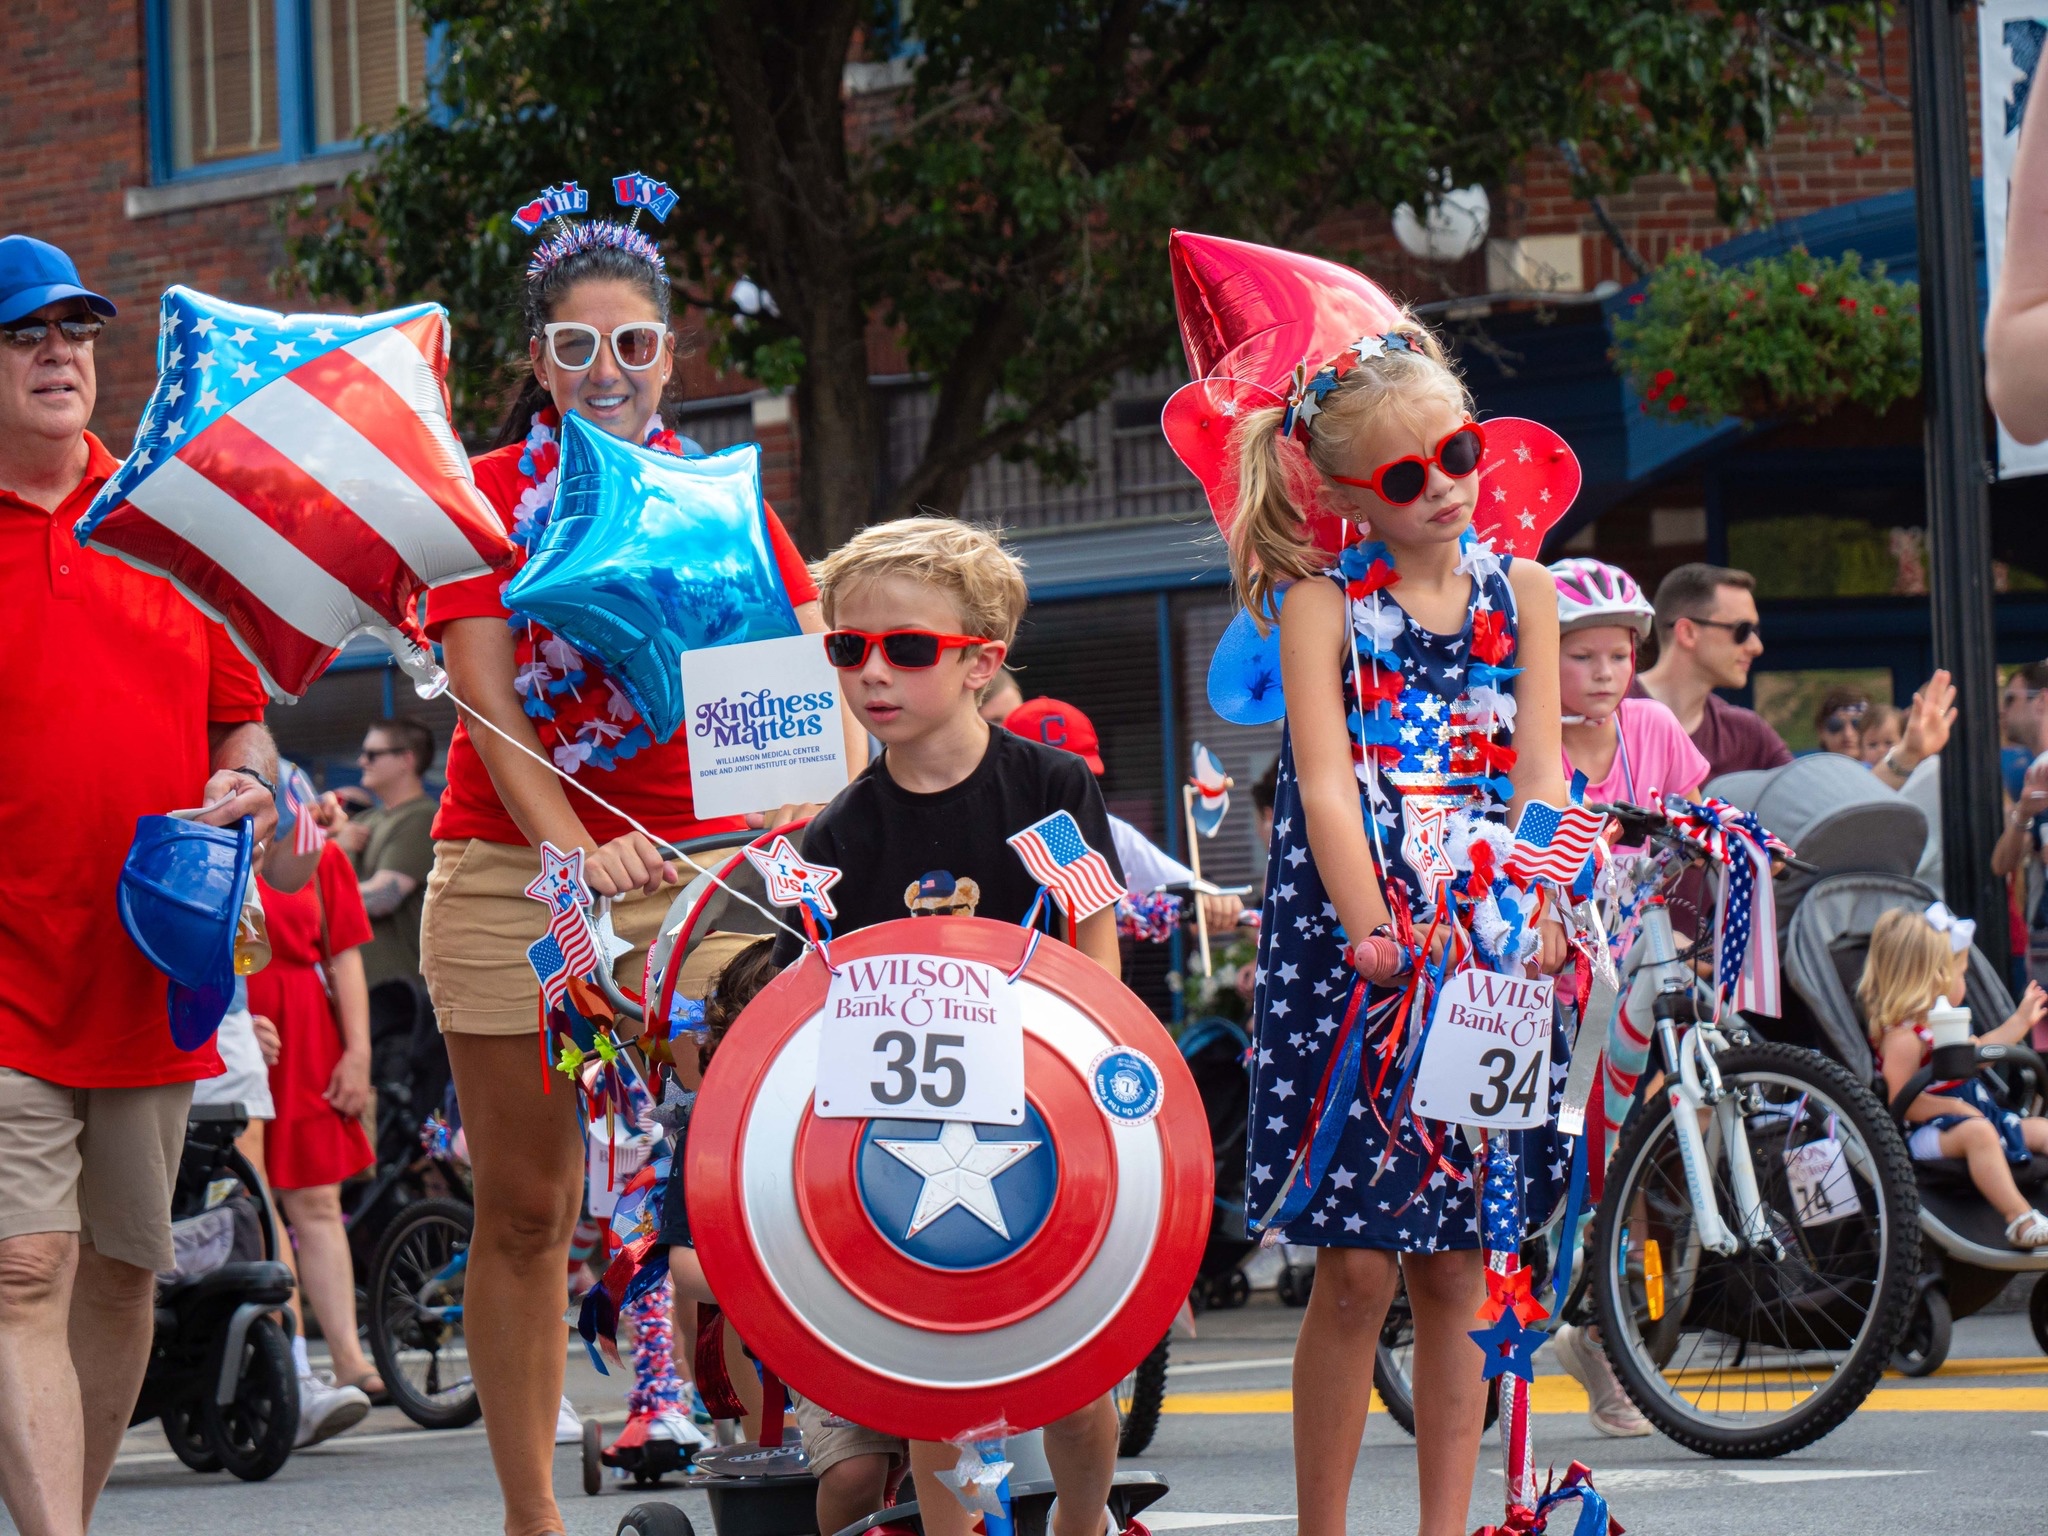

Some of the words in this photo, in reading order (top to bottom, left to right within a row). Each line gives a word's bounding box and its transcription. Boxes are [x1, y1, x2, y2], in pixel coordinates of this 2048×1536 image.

[513, 216, 533, 231] I
[542, 190, 585, 215] THE
[617, 177, 677, 219] USA
[694, 688, 834, 738] Kindness
[713, 713, 823, 751] Matters
[1040, 714, 1067, 746] C
[700, 768, 718, 778] BONE
[719, 766, 733, 775] AND
[734, 763, 753, 773] JOINT
[754, 759, 787, 770] INSTITUTE
[788, 757, 798, 766] OF
[798, 753, 836, 764] TENNESSEE
[715, 753, 760, 766] WILLIAMSON
[761, 749, 791, 760] MEDICAL
[792, 745, 820, 755] CENTER
[1414, 837, 1422, 852] I
[1419, 845, 1439, 872] USA
[549, 874, 559, 888] I
[778, 863, 789, 876] I
[777, 875, 816, 895] USA
[848, 958, 990, 999] WILSON
[1467, 972, 1554, 1011] WILSO
[835, 993, 896, 1019] Bank
[900, 988, 934, 1027] &
[938, 997, 998, 1025] Trust
[1448, 1003, 1509, 1037] Bank
[1511, 1012, 1538, 1047] &
[870, 1030, 966, 1108] 35
[1469, 1047, 1544, 1118] 34
[1107, 1099, 1120, 1113] The
[1122, 1107, 1133, 1116] On
[1134, 1089, 1156, 1114] Franklin
